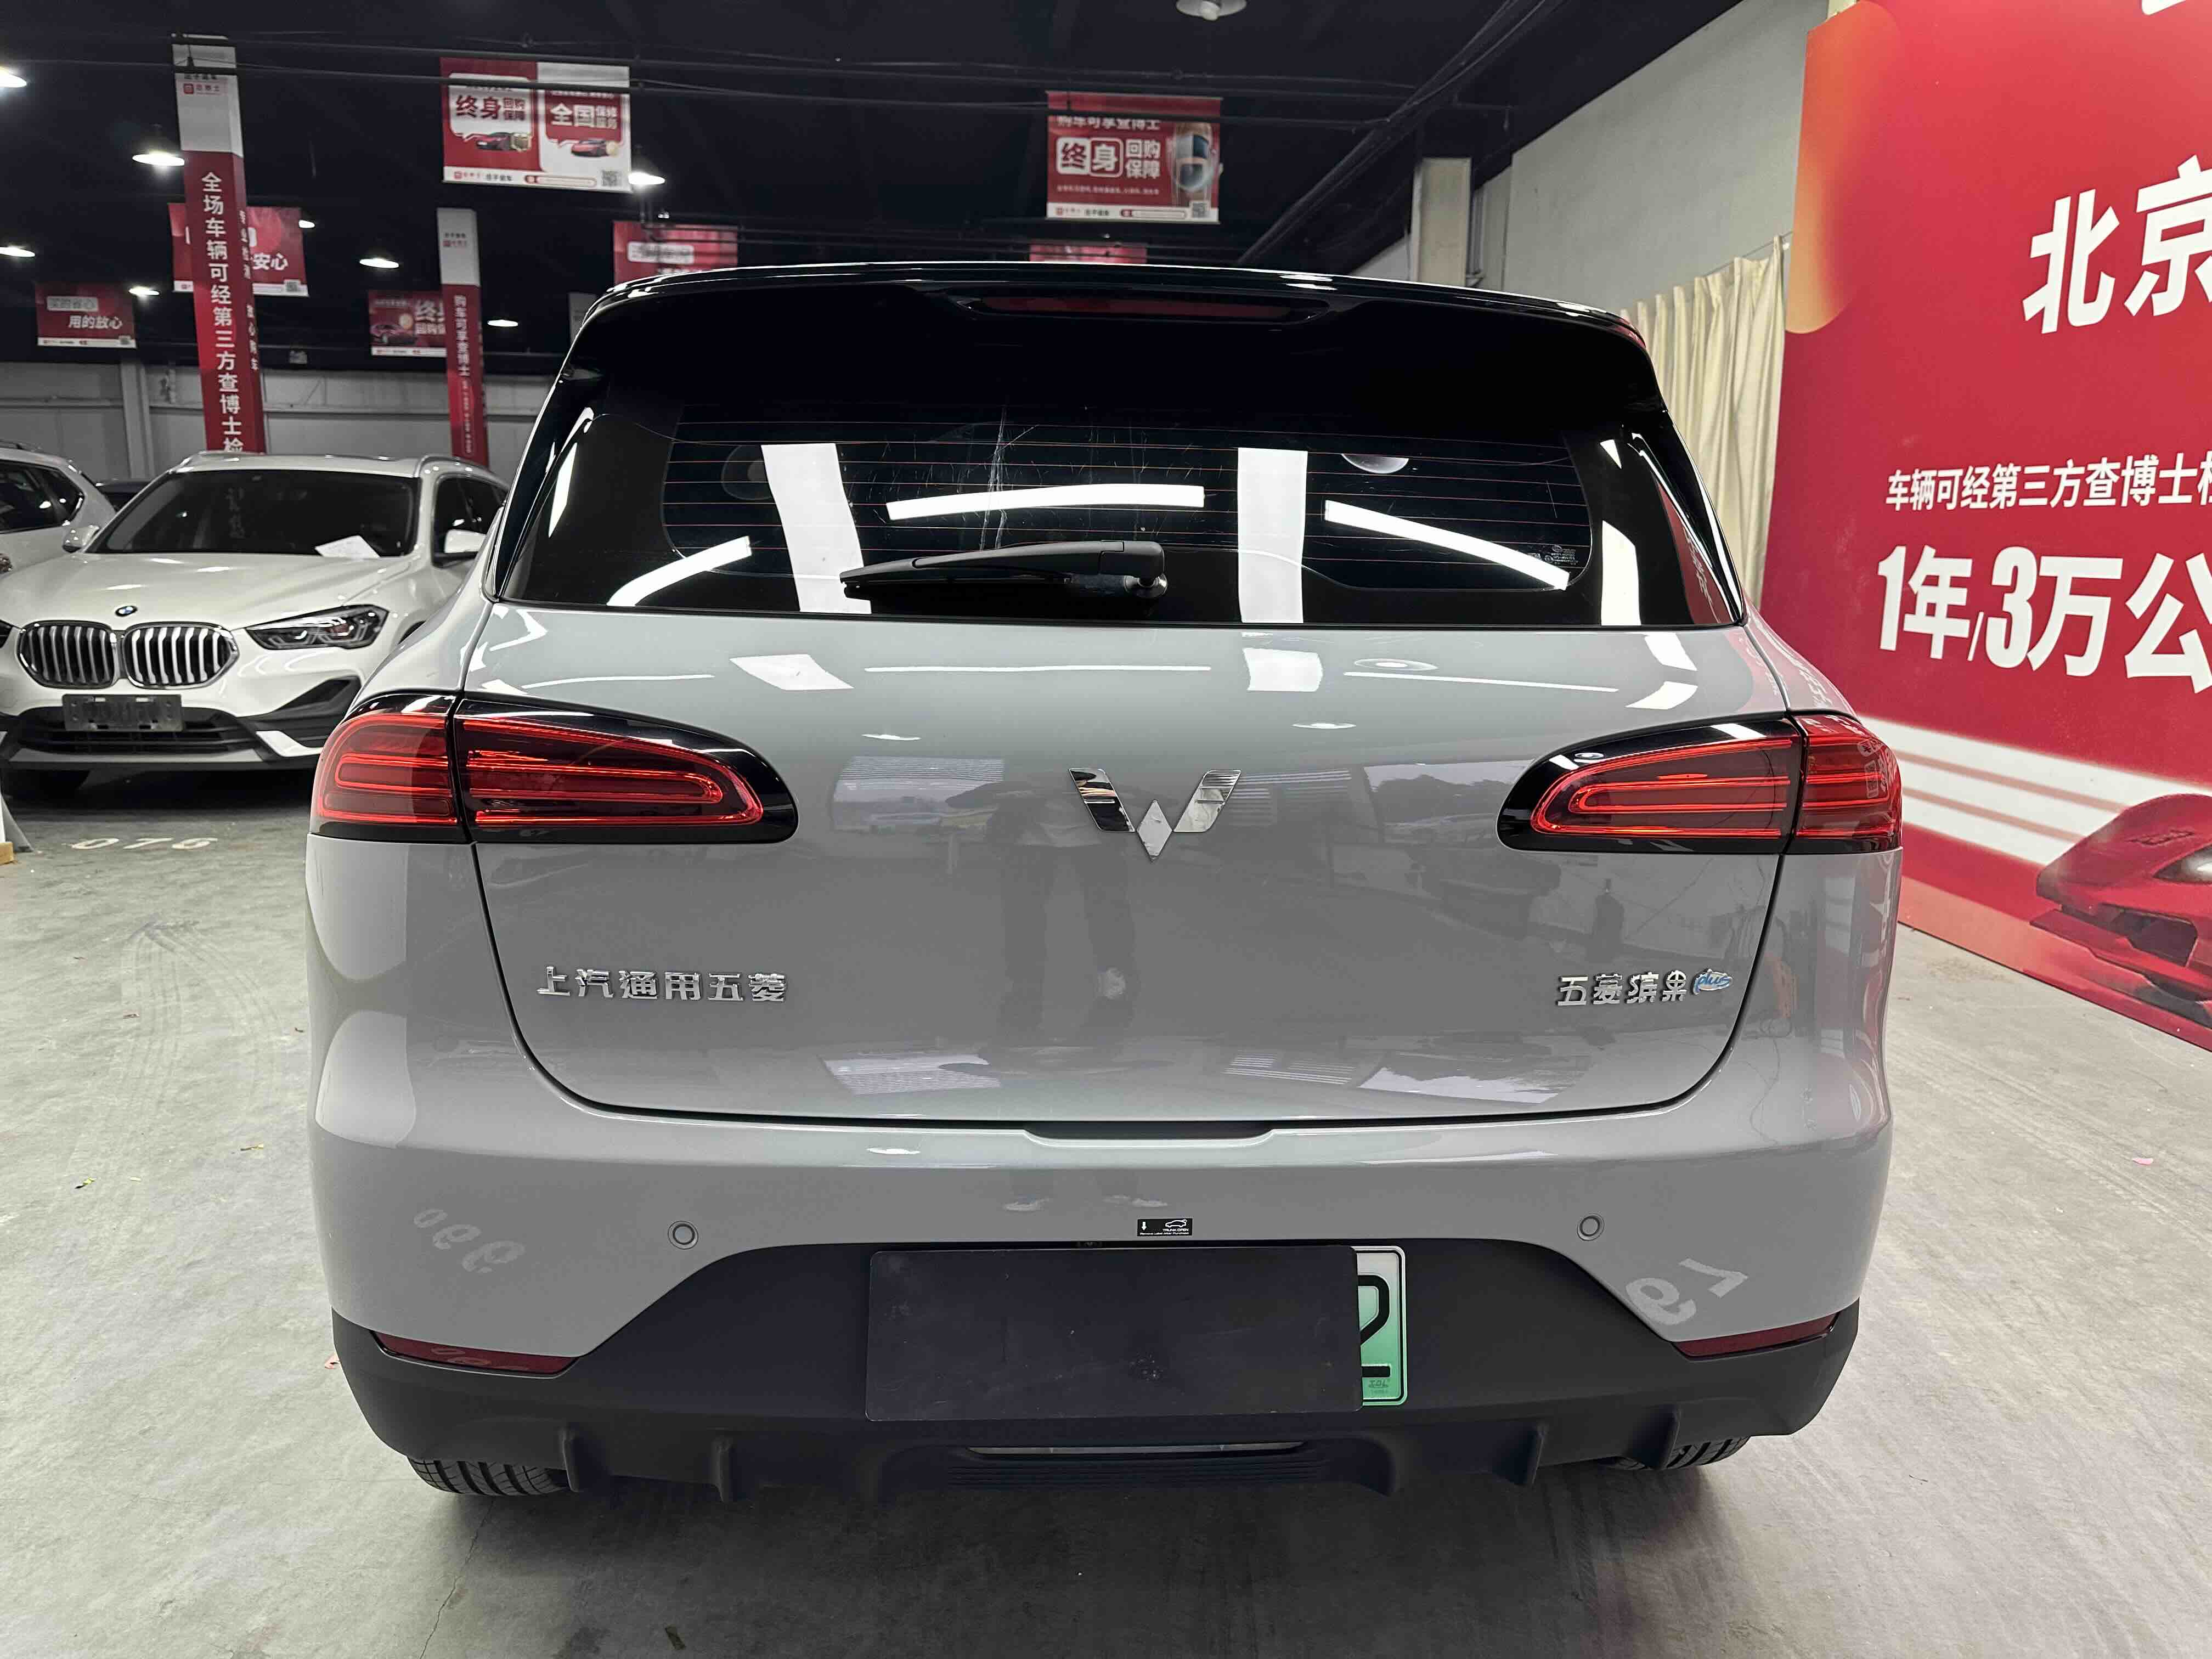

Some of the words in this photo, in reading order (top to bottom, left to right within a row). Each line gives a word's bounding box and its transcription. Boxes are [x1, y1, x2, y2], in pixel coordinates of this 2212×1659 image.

[456, 95, 500, 120] 终身
[550, 103, 595, 127] 全国
[1062, 143, 1118, 172] 终身
[1126, 139, 1161, 159] 回购
[2023, 155, 2212, 334] 北京
[253, 253, 288, 270] 安心
[69, 315, 123, 329] 用的放心
[537, 966, 786, 1001] 上汽通用五菱
[1558, 970, 1687, 1006] 五菱缤果
